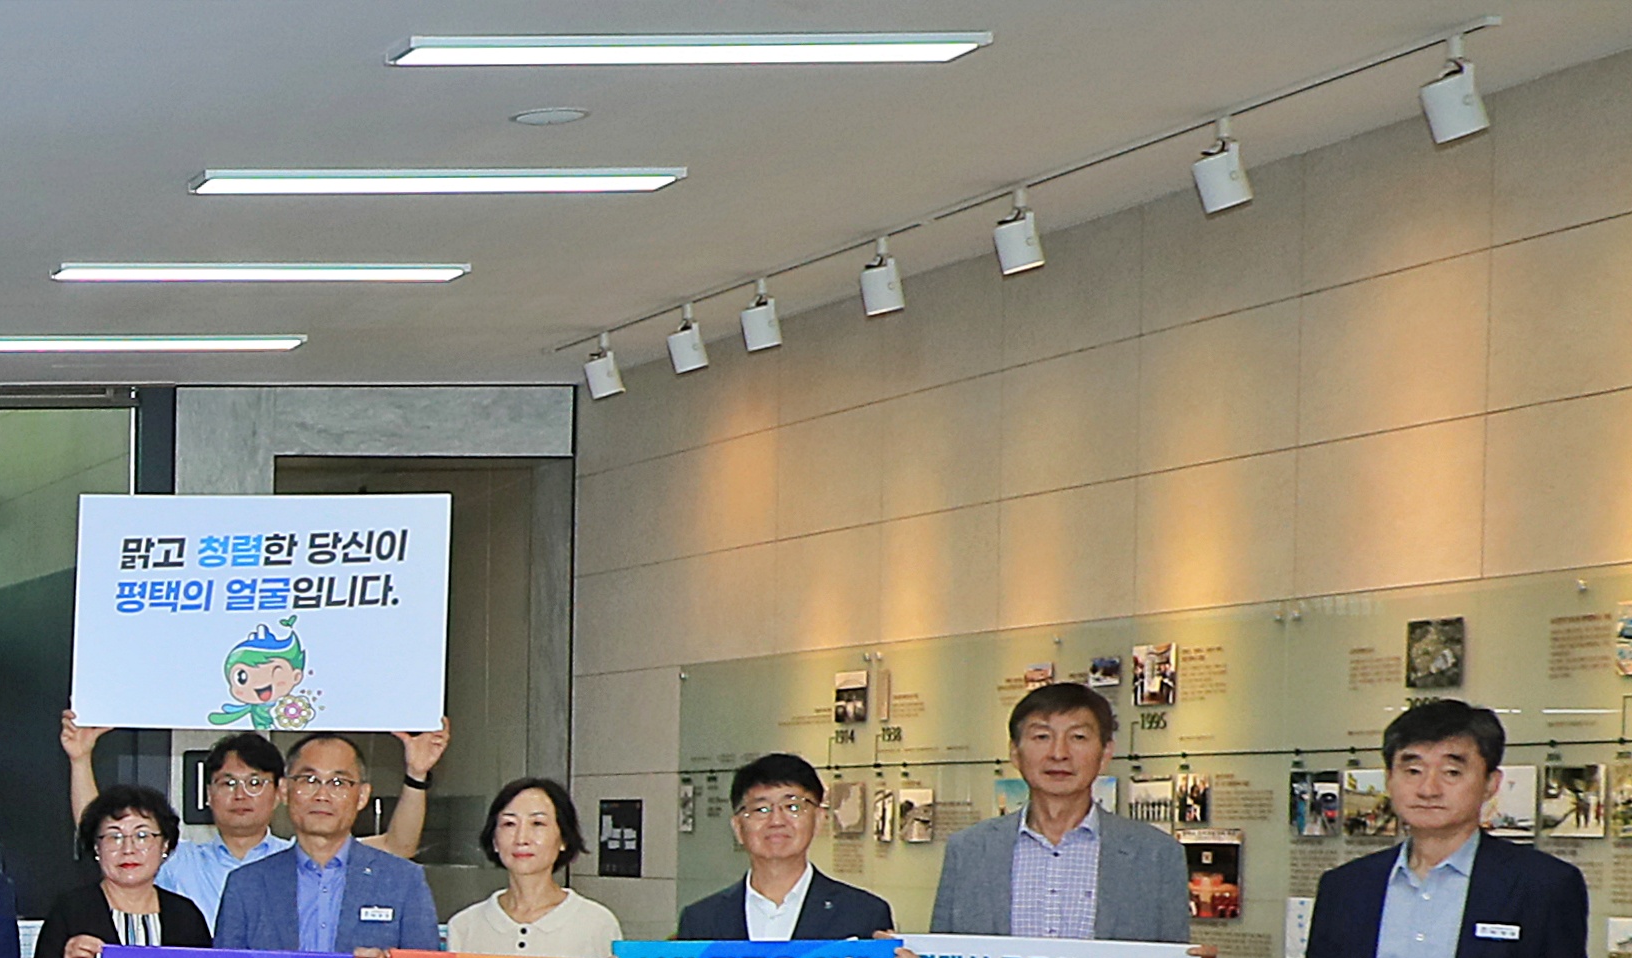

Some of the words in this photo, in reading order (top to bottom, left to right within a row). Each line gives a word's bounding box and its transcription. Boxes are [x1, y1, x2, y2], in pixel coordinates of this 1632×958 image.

[120, 537, 186, 570] 맑고
[197, 533, 298, 567] 청렴한
[308, 529, 408, 564] 당신이
[115, 579, 213, 613] 평택의
[225, 573, 399, 611] 얼굴입니다.
